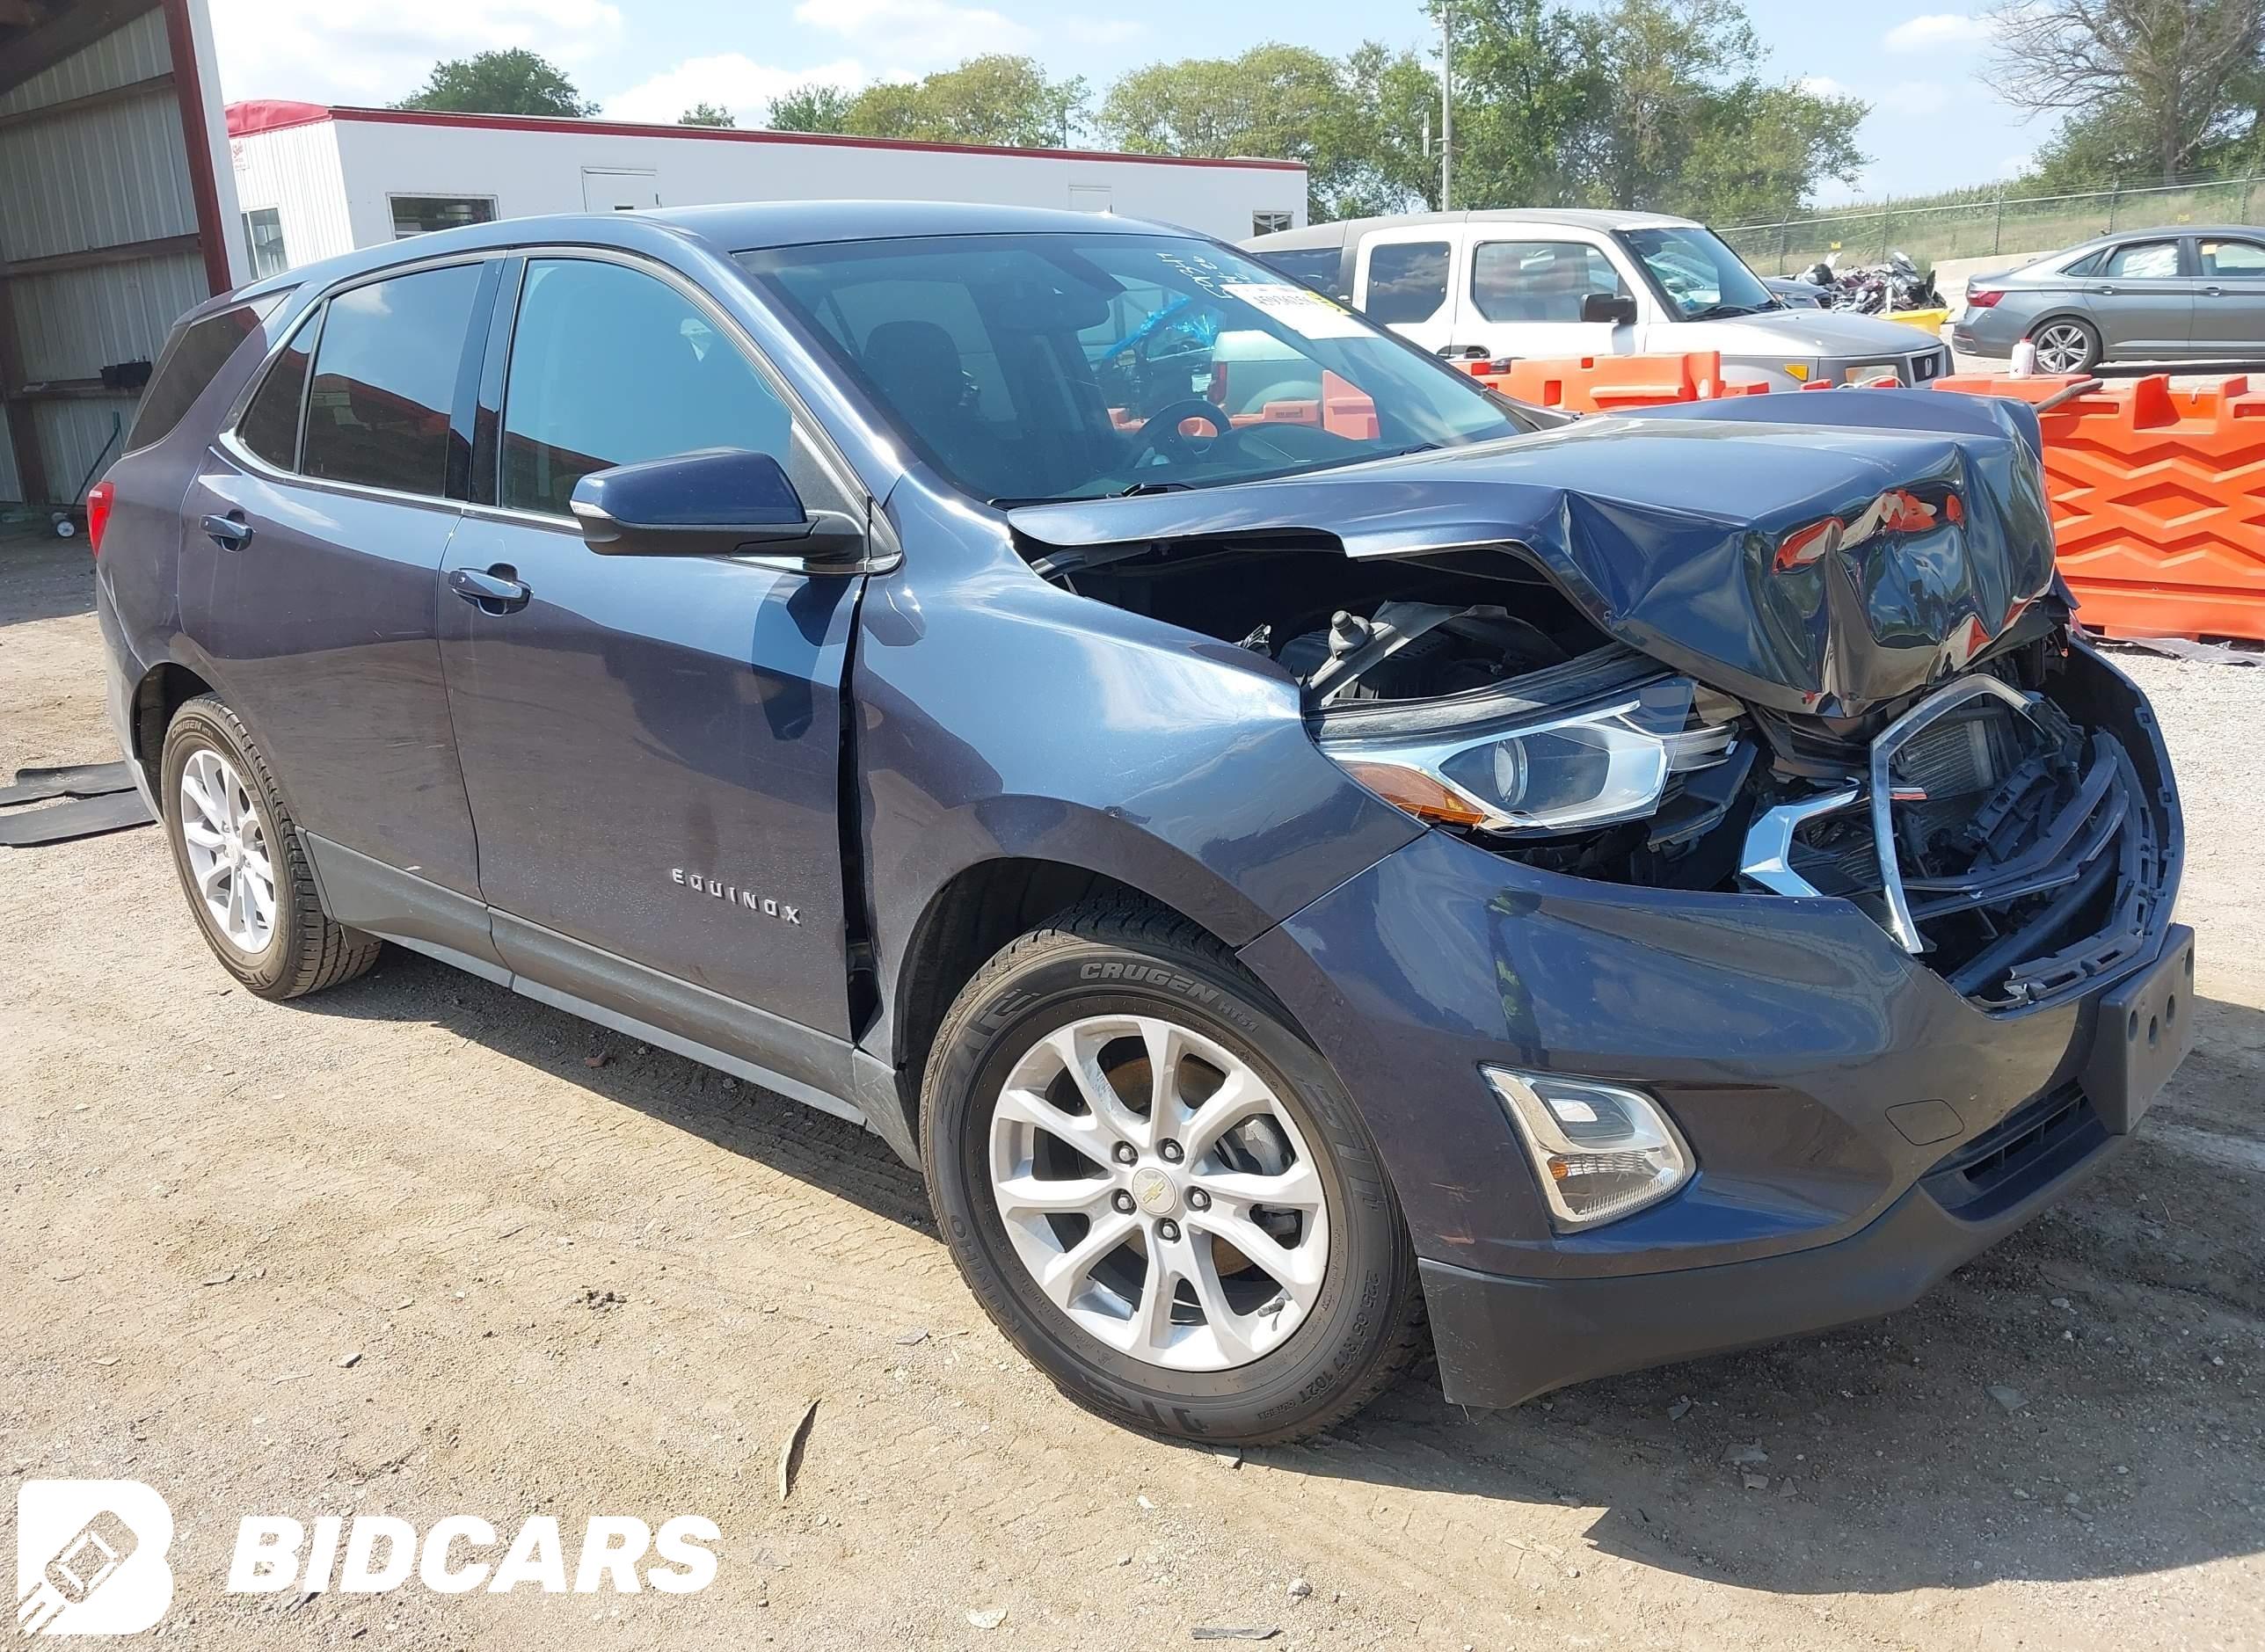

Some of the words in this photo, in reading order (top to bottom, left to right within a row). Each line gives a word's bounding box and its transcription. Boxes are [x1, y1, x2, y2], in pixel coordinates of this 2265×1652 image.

[671, 868, 801, 926] EQUINOX
[1080, 962, 1220, 1006] CRUGEN
[950, 1214, 1023, 1335] KUMHO
